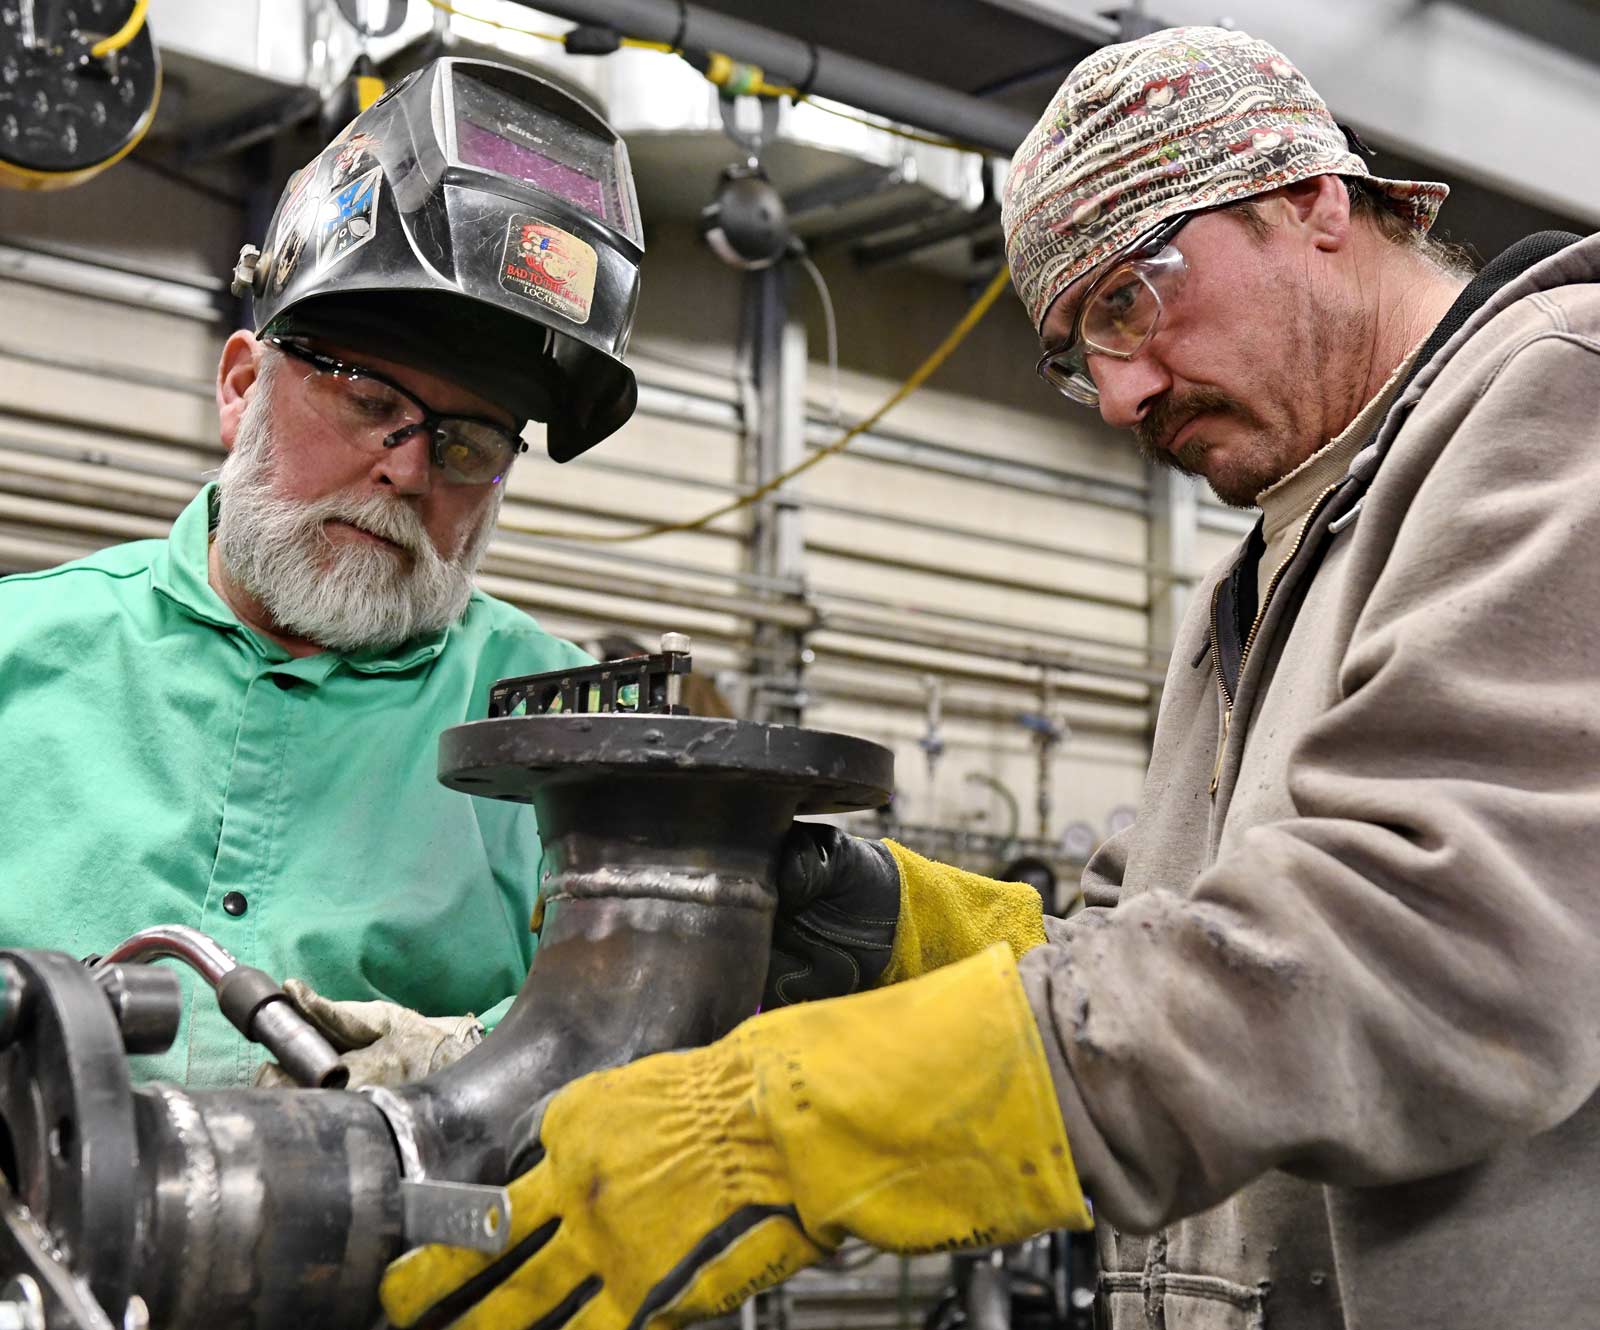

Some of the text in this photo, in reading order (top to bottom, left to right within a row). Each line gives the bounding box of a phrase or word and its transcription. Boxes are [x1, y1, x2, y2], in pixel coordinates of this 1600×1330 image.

[1181, 95, 1208, 111] SHIT
[507, 264, 529, 280] BAD
[529, 272, 544, 286] TO
[523, 285, 555, 305] LOCAL
